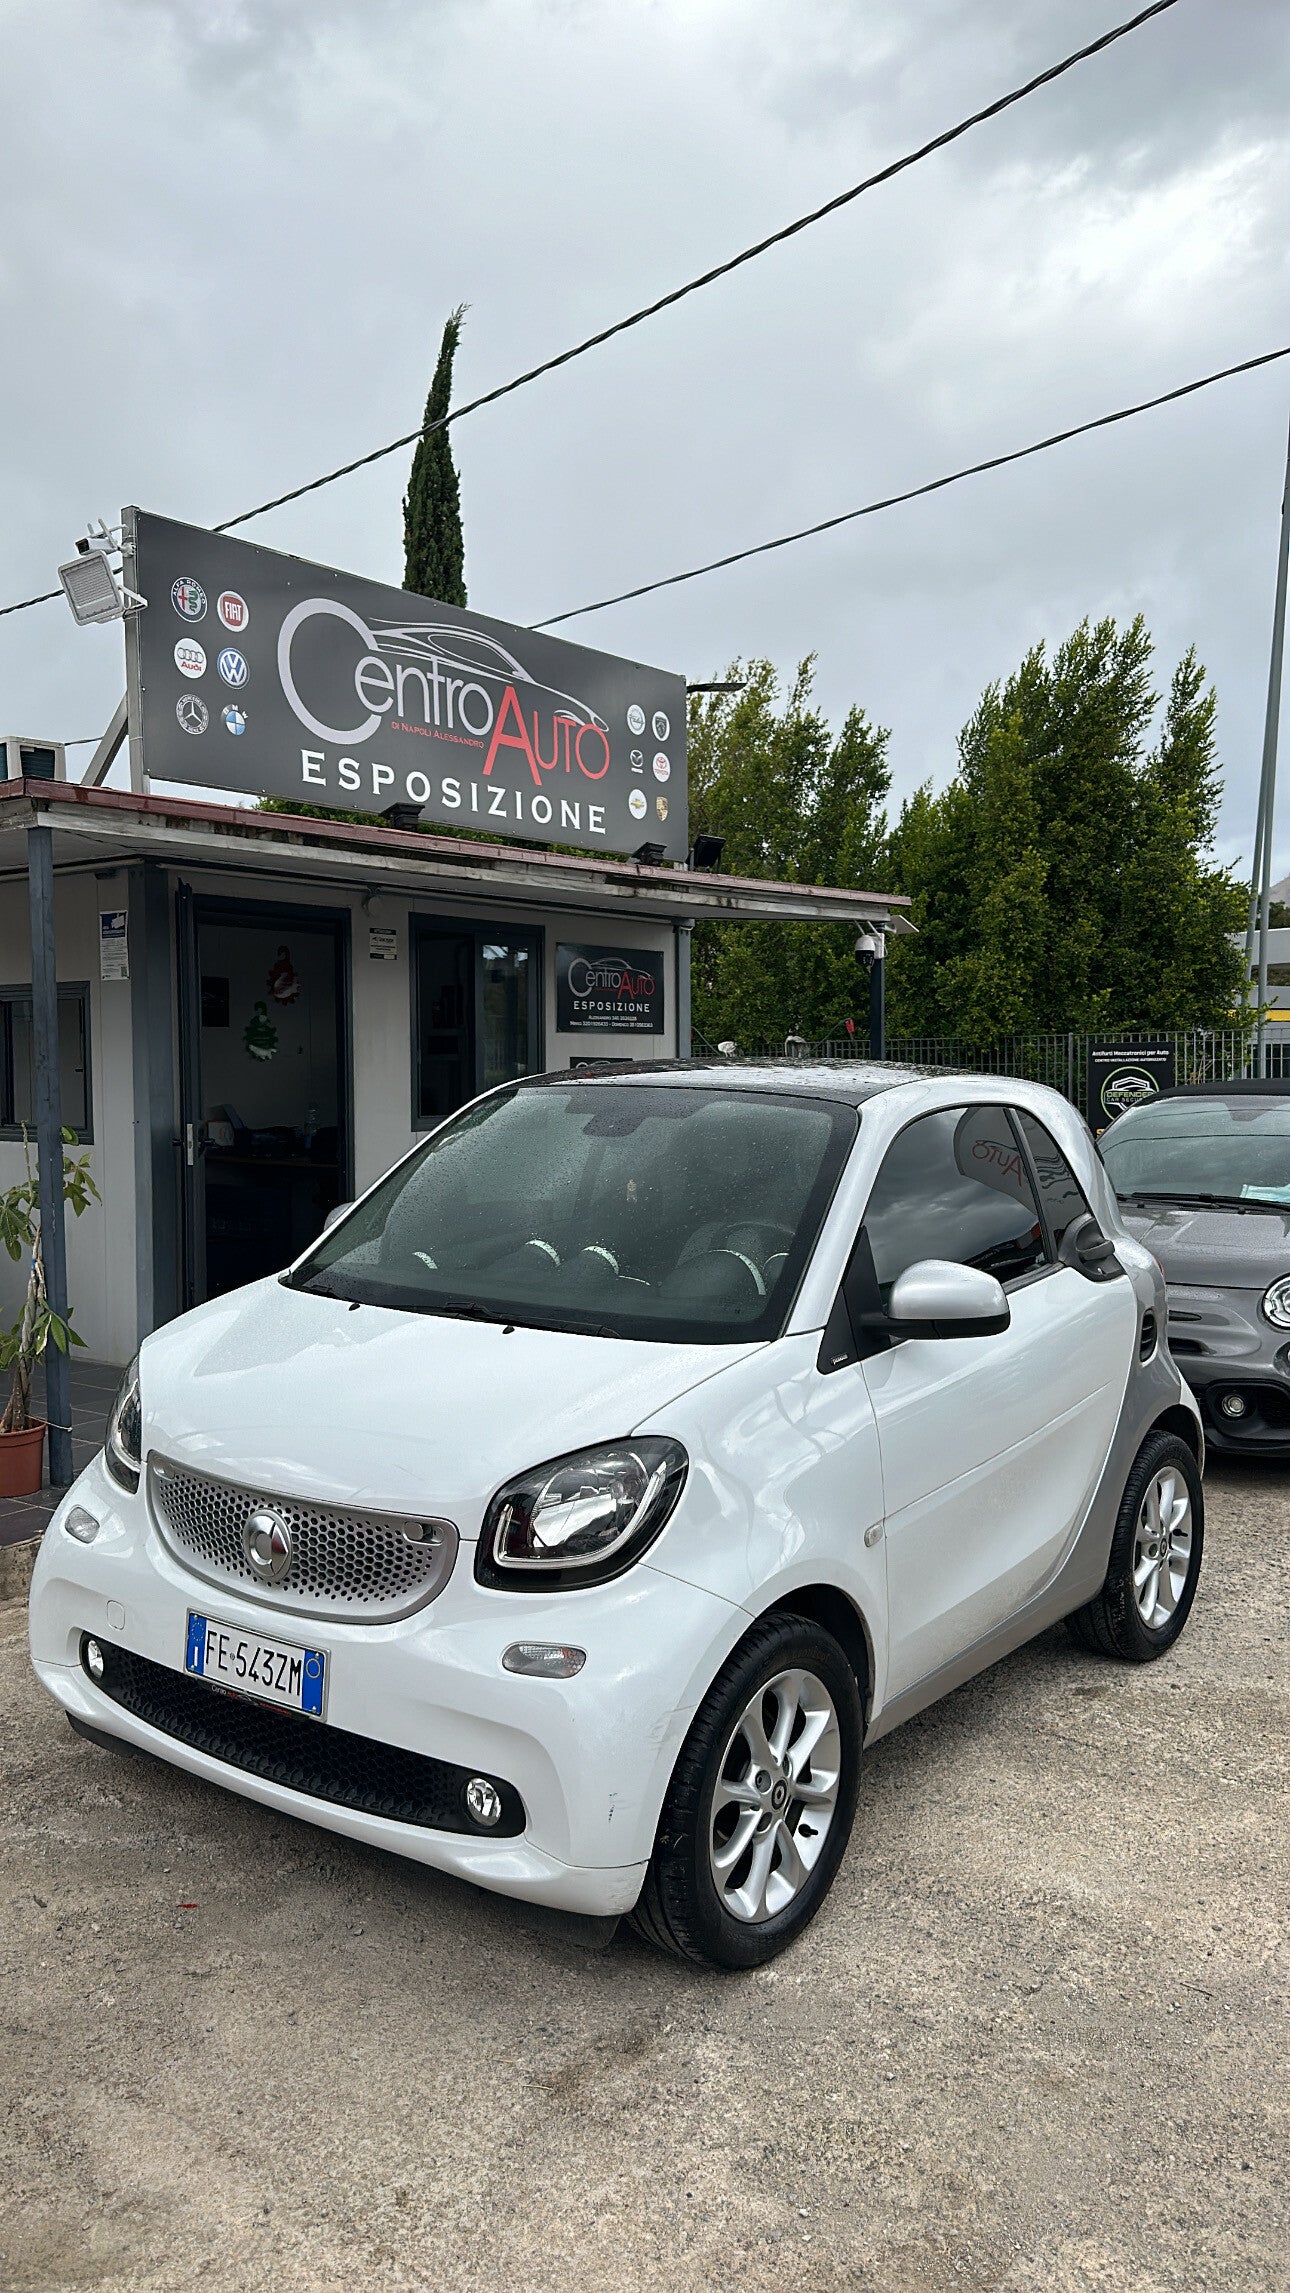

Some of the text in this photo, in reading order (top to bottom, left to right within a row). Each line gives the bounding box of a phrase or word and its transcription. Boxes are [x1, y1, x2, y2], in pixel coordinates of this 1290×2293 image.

[224, 601, 242, 622] FIAT
[300, 748, 606, 834] ESPOSIZIONE
[573, 1001, 650, 1012] ESPOSIZIONE
